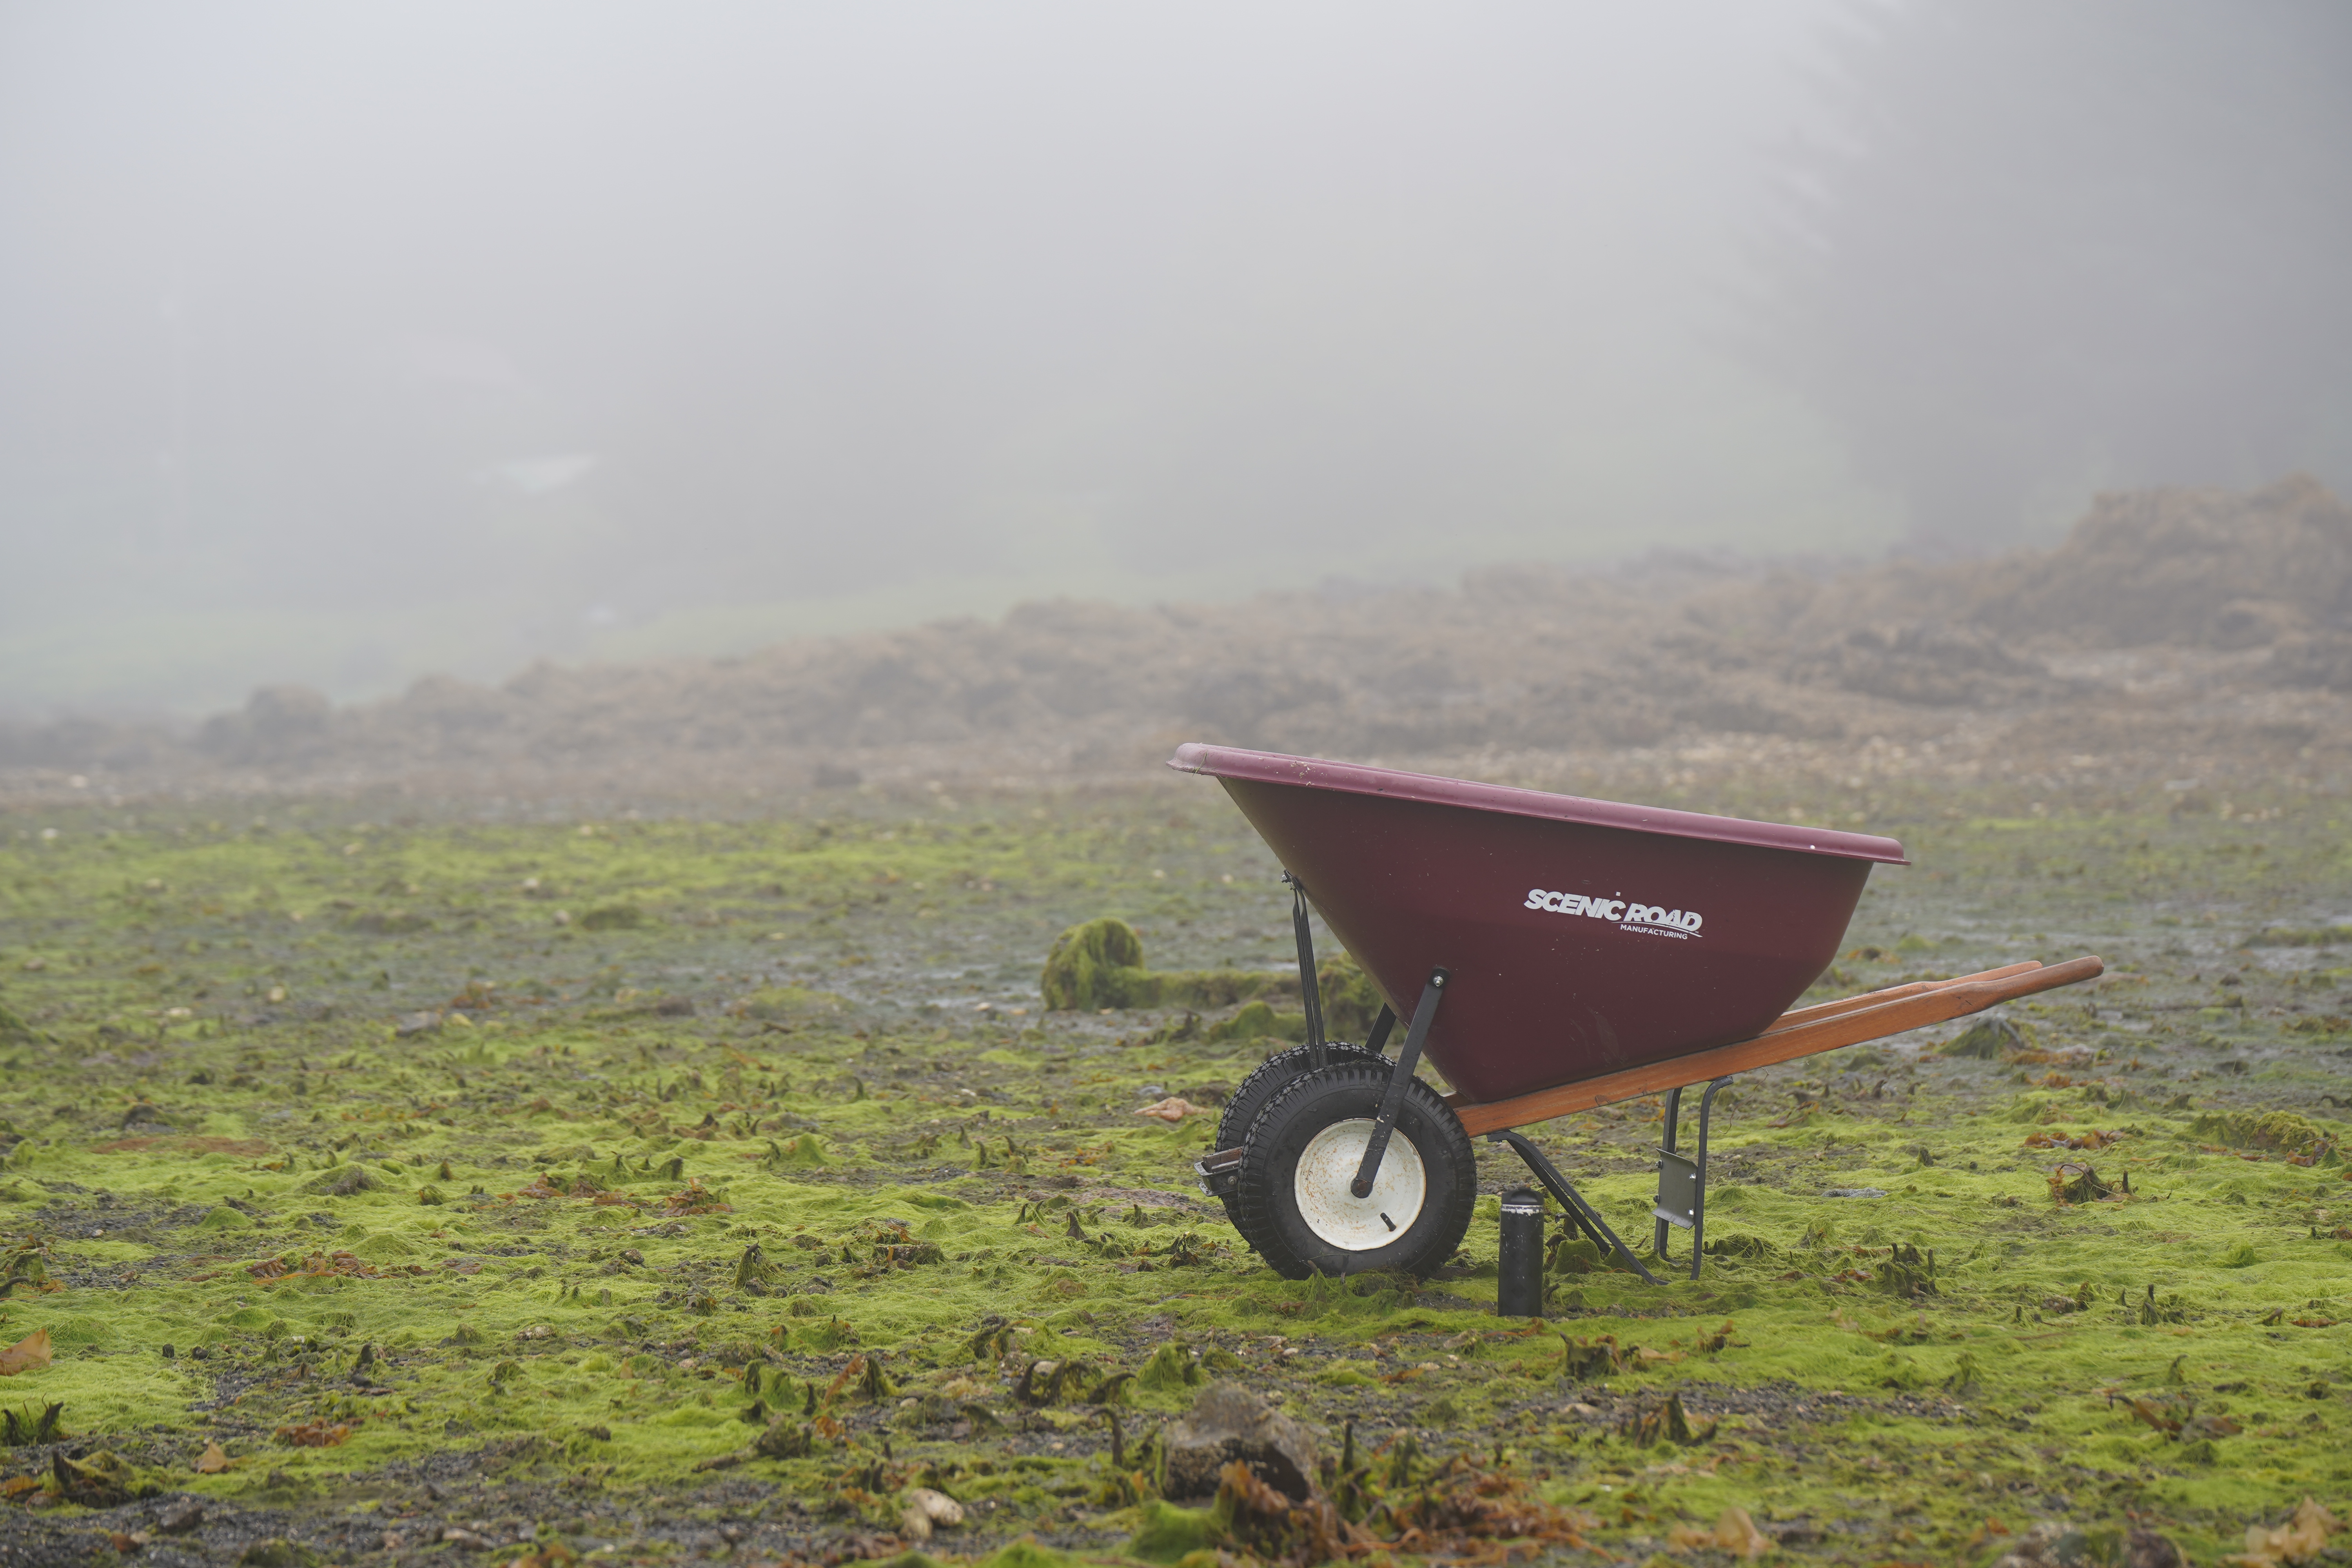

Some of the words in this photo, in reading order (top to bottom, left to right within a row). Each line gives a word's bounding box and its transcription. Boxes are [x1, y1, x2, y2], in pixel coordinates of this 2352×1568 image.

[1524, 889, 1626, 921] SCENIC
[1623, 903, 1702, 932] ROAD
[1620, 924, 1688, 940] MANUFACTURING
